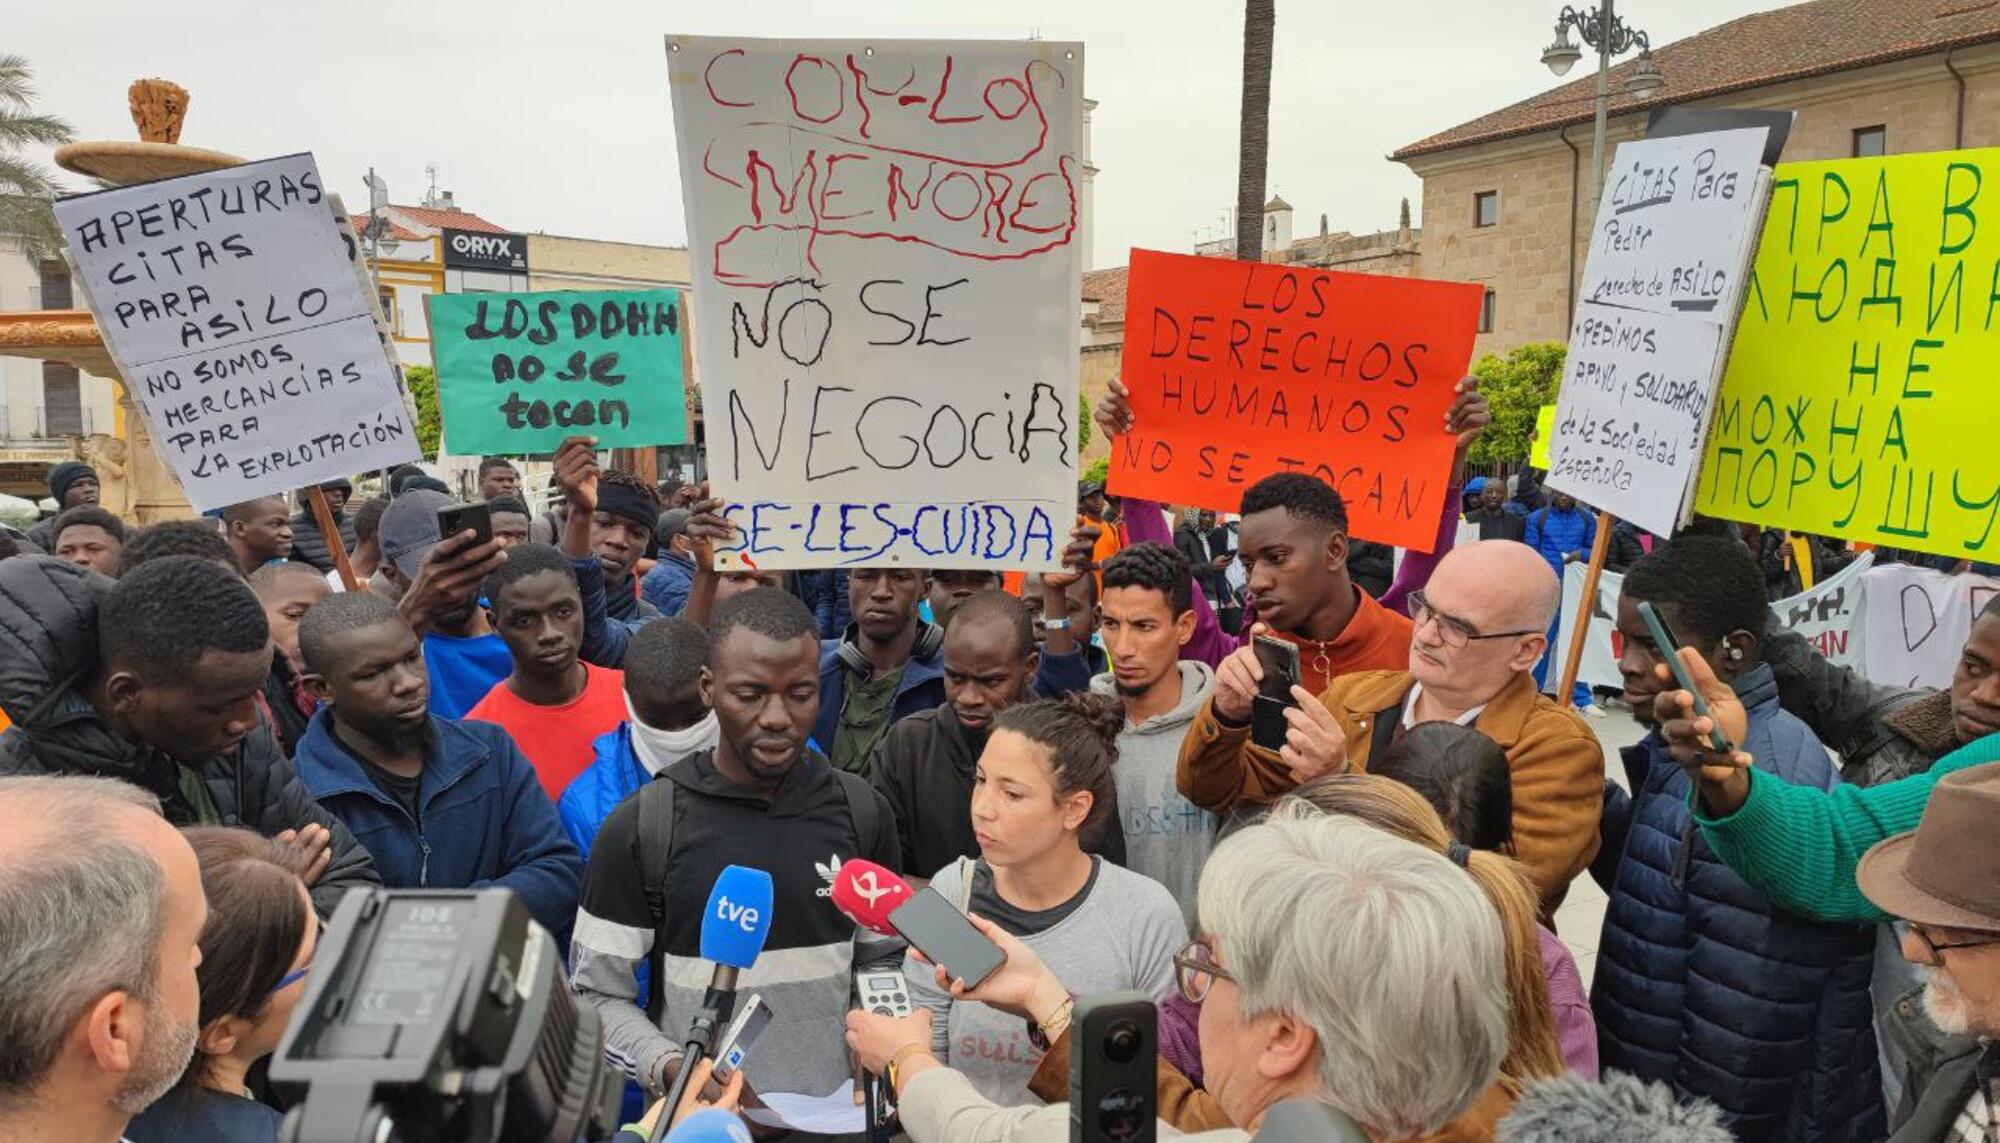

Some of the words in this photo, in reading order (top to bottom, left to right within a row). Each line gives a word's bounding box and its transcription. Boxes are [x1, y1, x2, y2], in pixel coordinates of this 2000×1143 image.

[76, 171, 321, 253] APERTURAS
[738, 150, 1076, 258] MENORES
[452, 234, 511, 257] ORYX
[114, 285, 210, 328] PARA
[1243, 265, 1330, 318] LOS
[570, 300, 678, 339] DDHH
[732, 278, 832, 366] NO
[860, 279, 970, 346] SE
[147, 369, 180, 398] NO
[194, 344, 294, 383] SOMOS
[1150, 308, 1428, 388] DERECHOS
[1849, 339, 1944, 399] НЕ
[498, 391, 629, 430] tocan
[1163, 373, 1410, 442] HUMANOS
[1716, 394, 1908, 462] МОЖНА
[167, 416, 259, 454] PARA
[1121, 436, 1173, 473] NO
[1199, 446, 1250, 483] SE
[192, 451, 230, 478] LA
[1711, 447, 2000, 551] ПОРУШУ
[716, 895, 759, 932] tve
